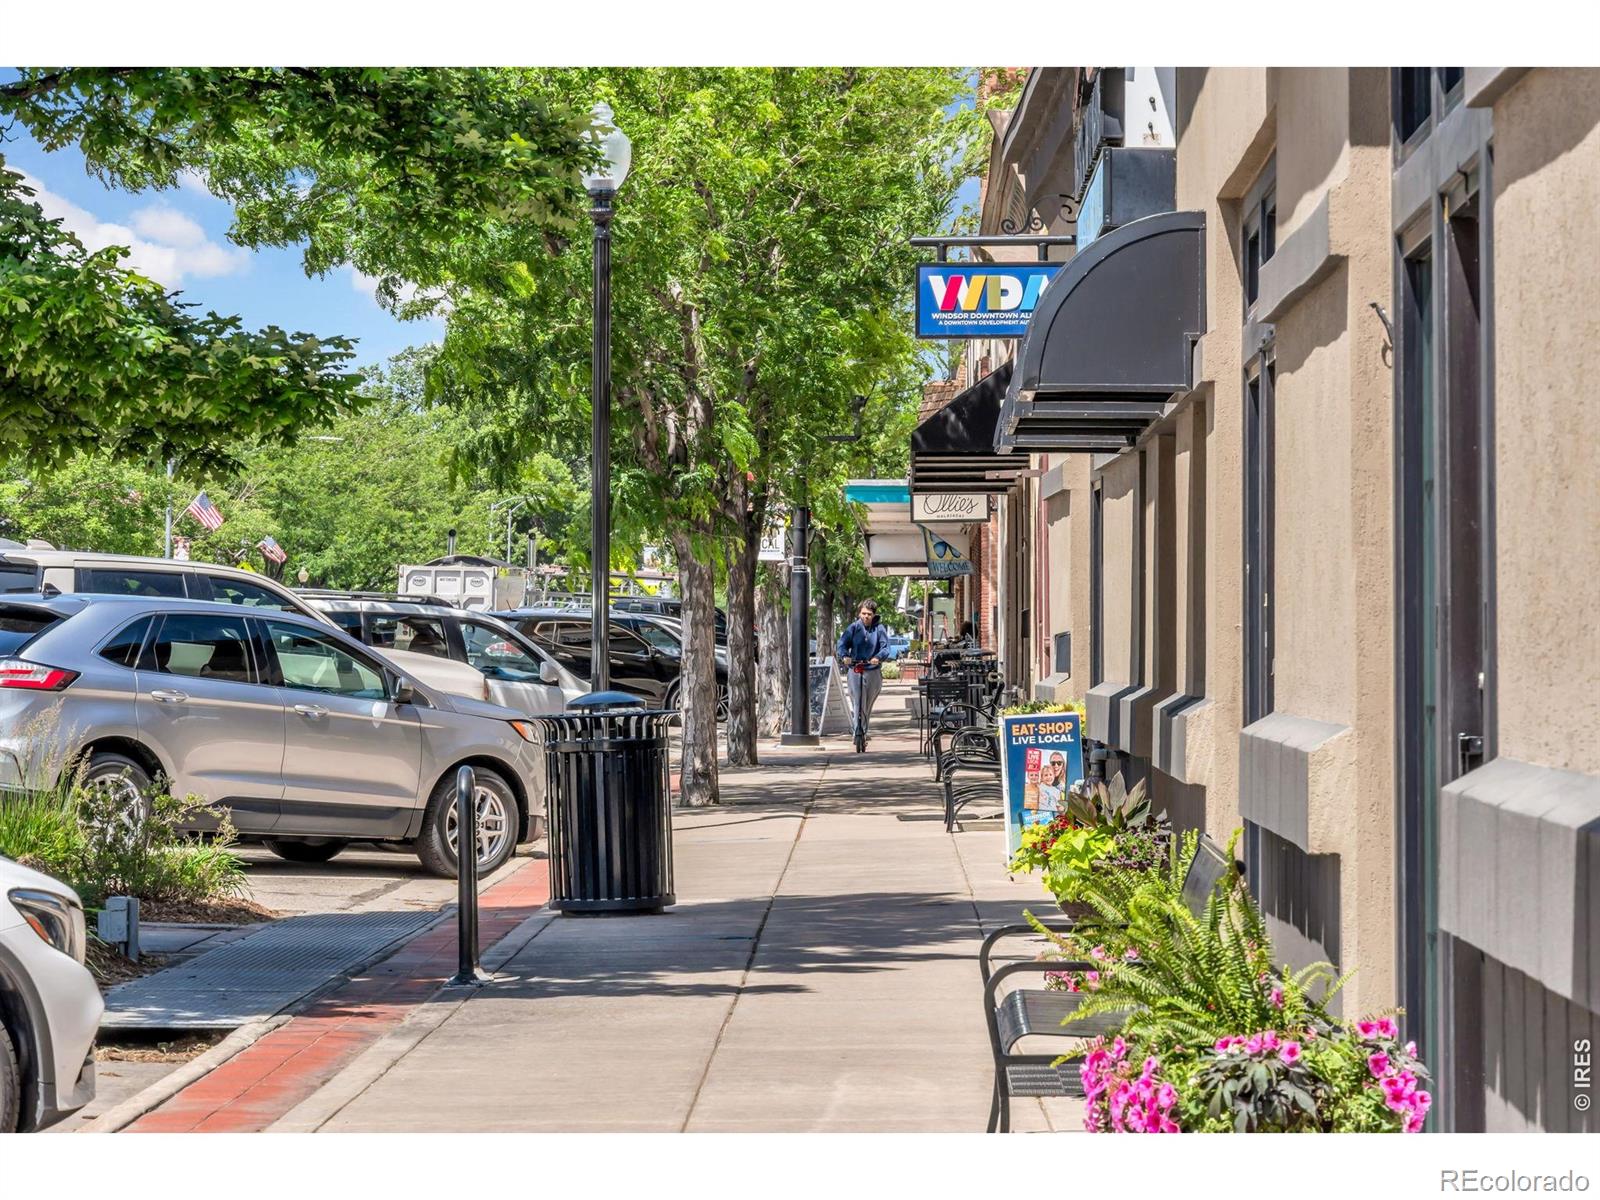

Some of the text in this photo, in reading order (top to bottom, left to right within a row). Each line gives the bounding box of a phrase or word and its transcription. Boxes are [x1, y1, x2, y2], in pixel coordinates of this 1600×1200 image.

[923, 494, 979, 515] Ollie's
[932, 561, 970, 573] WELCOME
[1012, 734, 1074, 745] LIVE LOCAL
